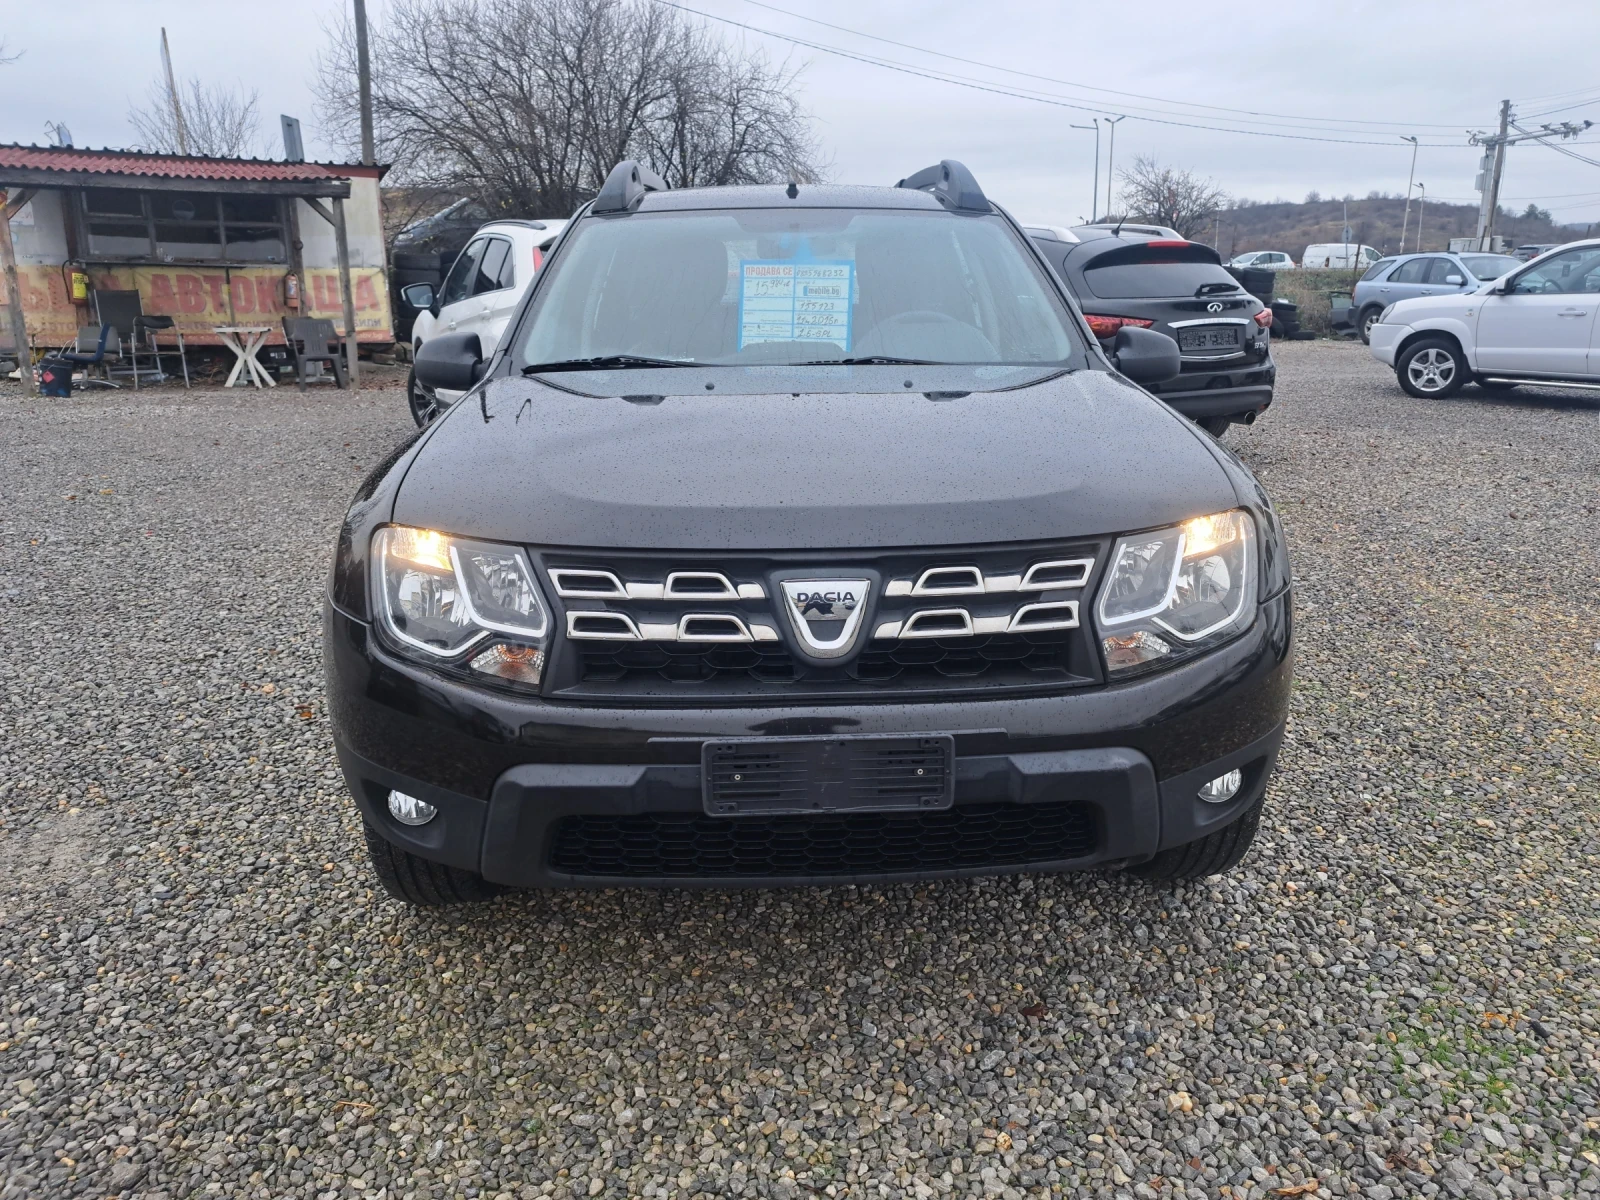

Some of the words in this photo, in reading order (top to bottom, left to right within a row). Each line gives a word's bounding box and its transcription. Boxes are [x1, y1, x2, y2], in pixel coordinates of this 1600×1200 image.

[746, 267, 781, 277] ПРОДАВА
[782, 267, 793, 276] СЕ
[797, 591, 856, 603] DACIA
